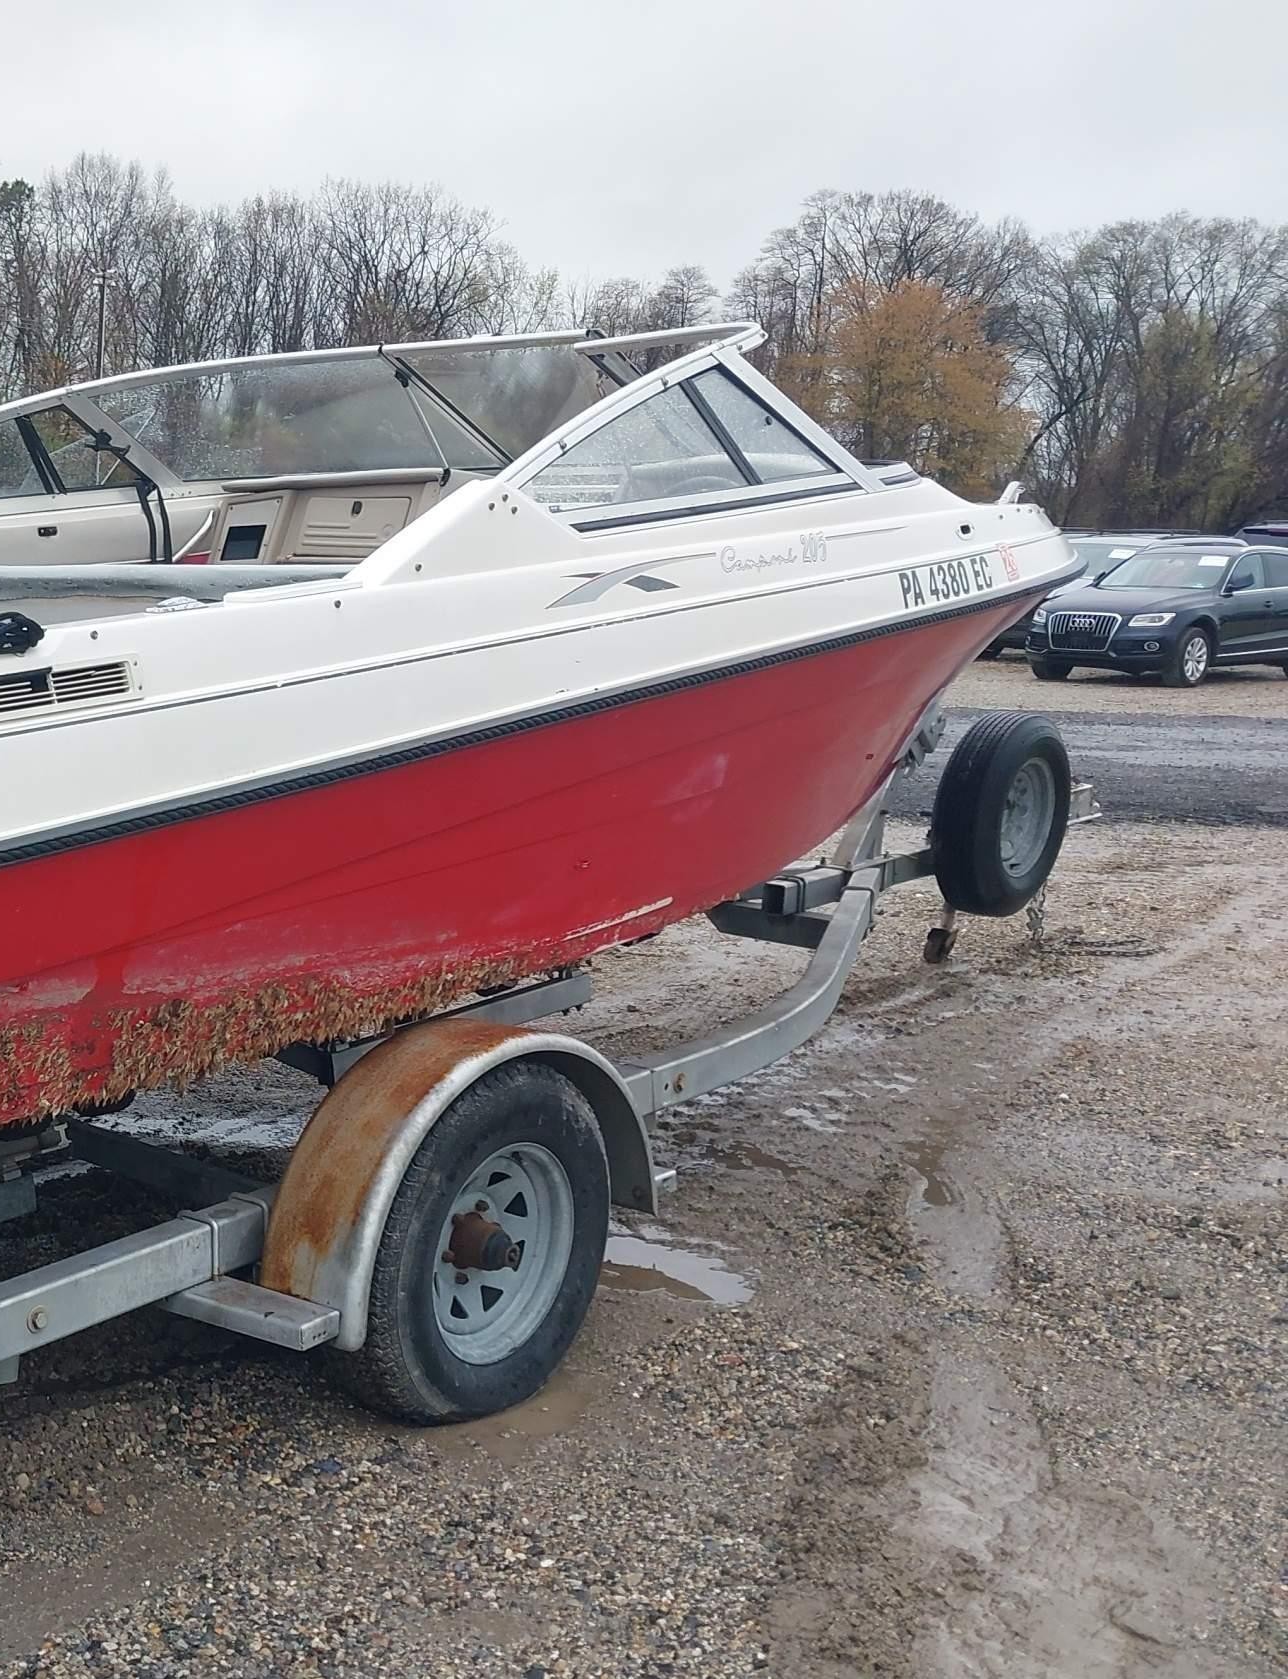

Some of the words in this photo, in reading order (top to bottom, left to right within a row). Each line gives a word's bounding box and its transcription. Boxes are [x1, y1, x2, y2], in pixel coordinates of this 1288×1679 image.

[899, 571, 926, 609] PA
[929, 560, 970, 605] 4380
[971, 556, 993, 593] EC
